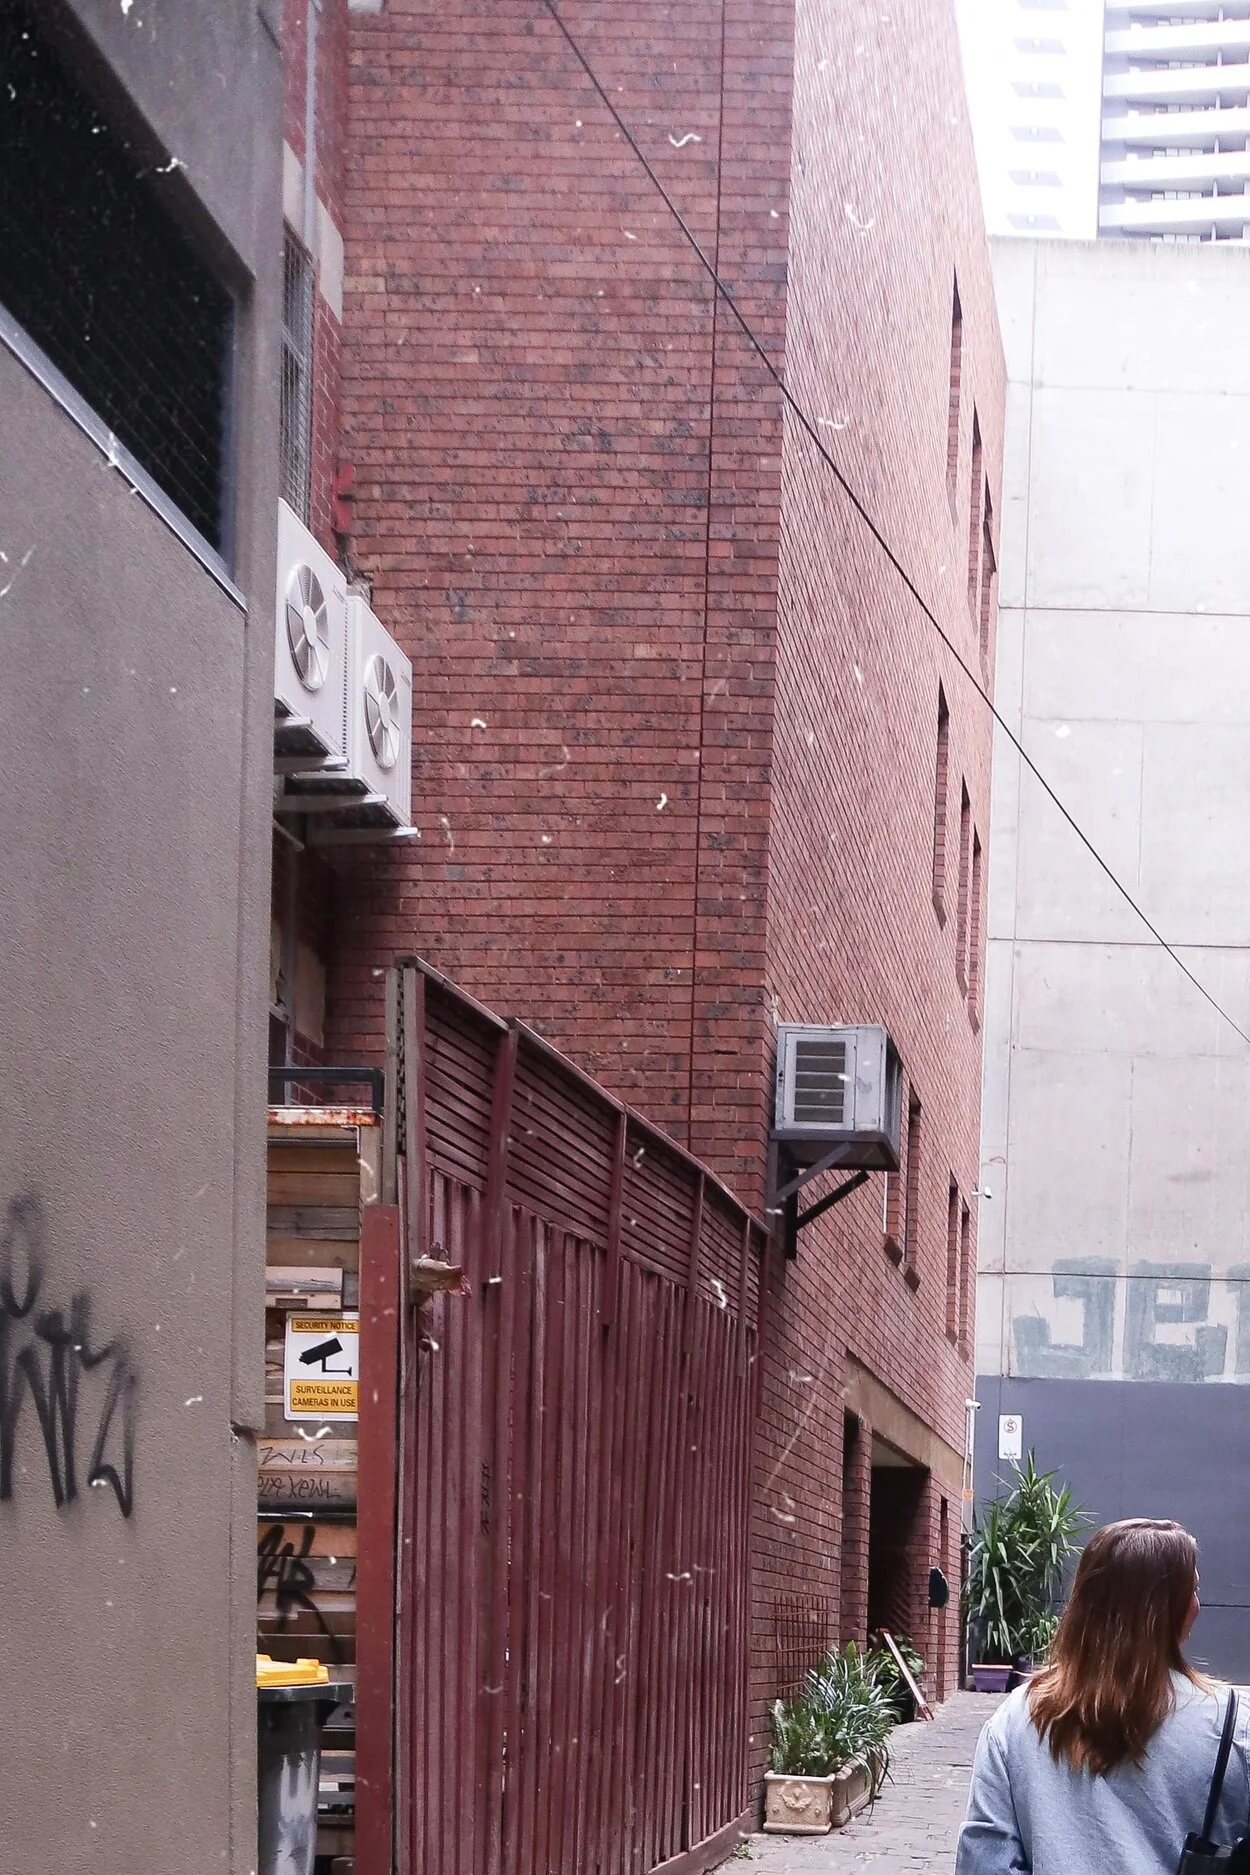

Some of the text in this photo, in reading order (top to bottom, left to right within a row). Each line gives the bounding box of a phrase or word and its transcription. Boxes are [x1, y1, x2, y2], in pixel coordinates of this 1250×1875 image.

[295, 1321, 356, 1330] SECURITY NOTICE
[295, 1385, 352, 1395] SURVEILLANCE
[292, 1398, 356, 1408] CAMERAS IN USE
